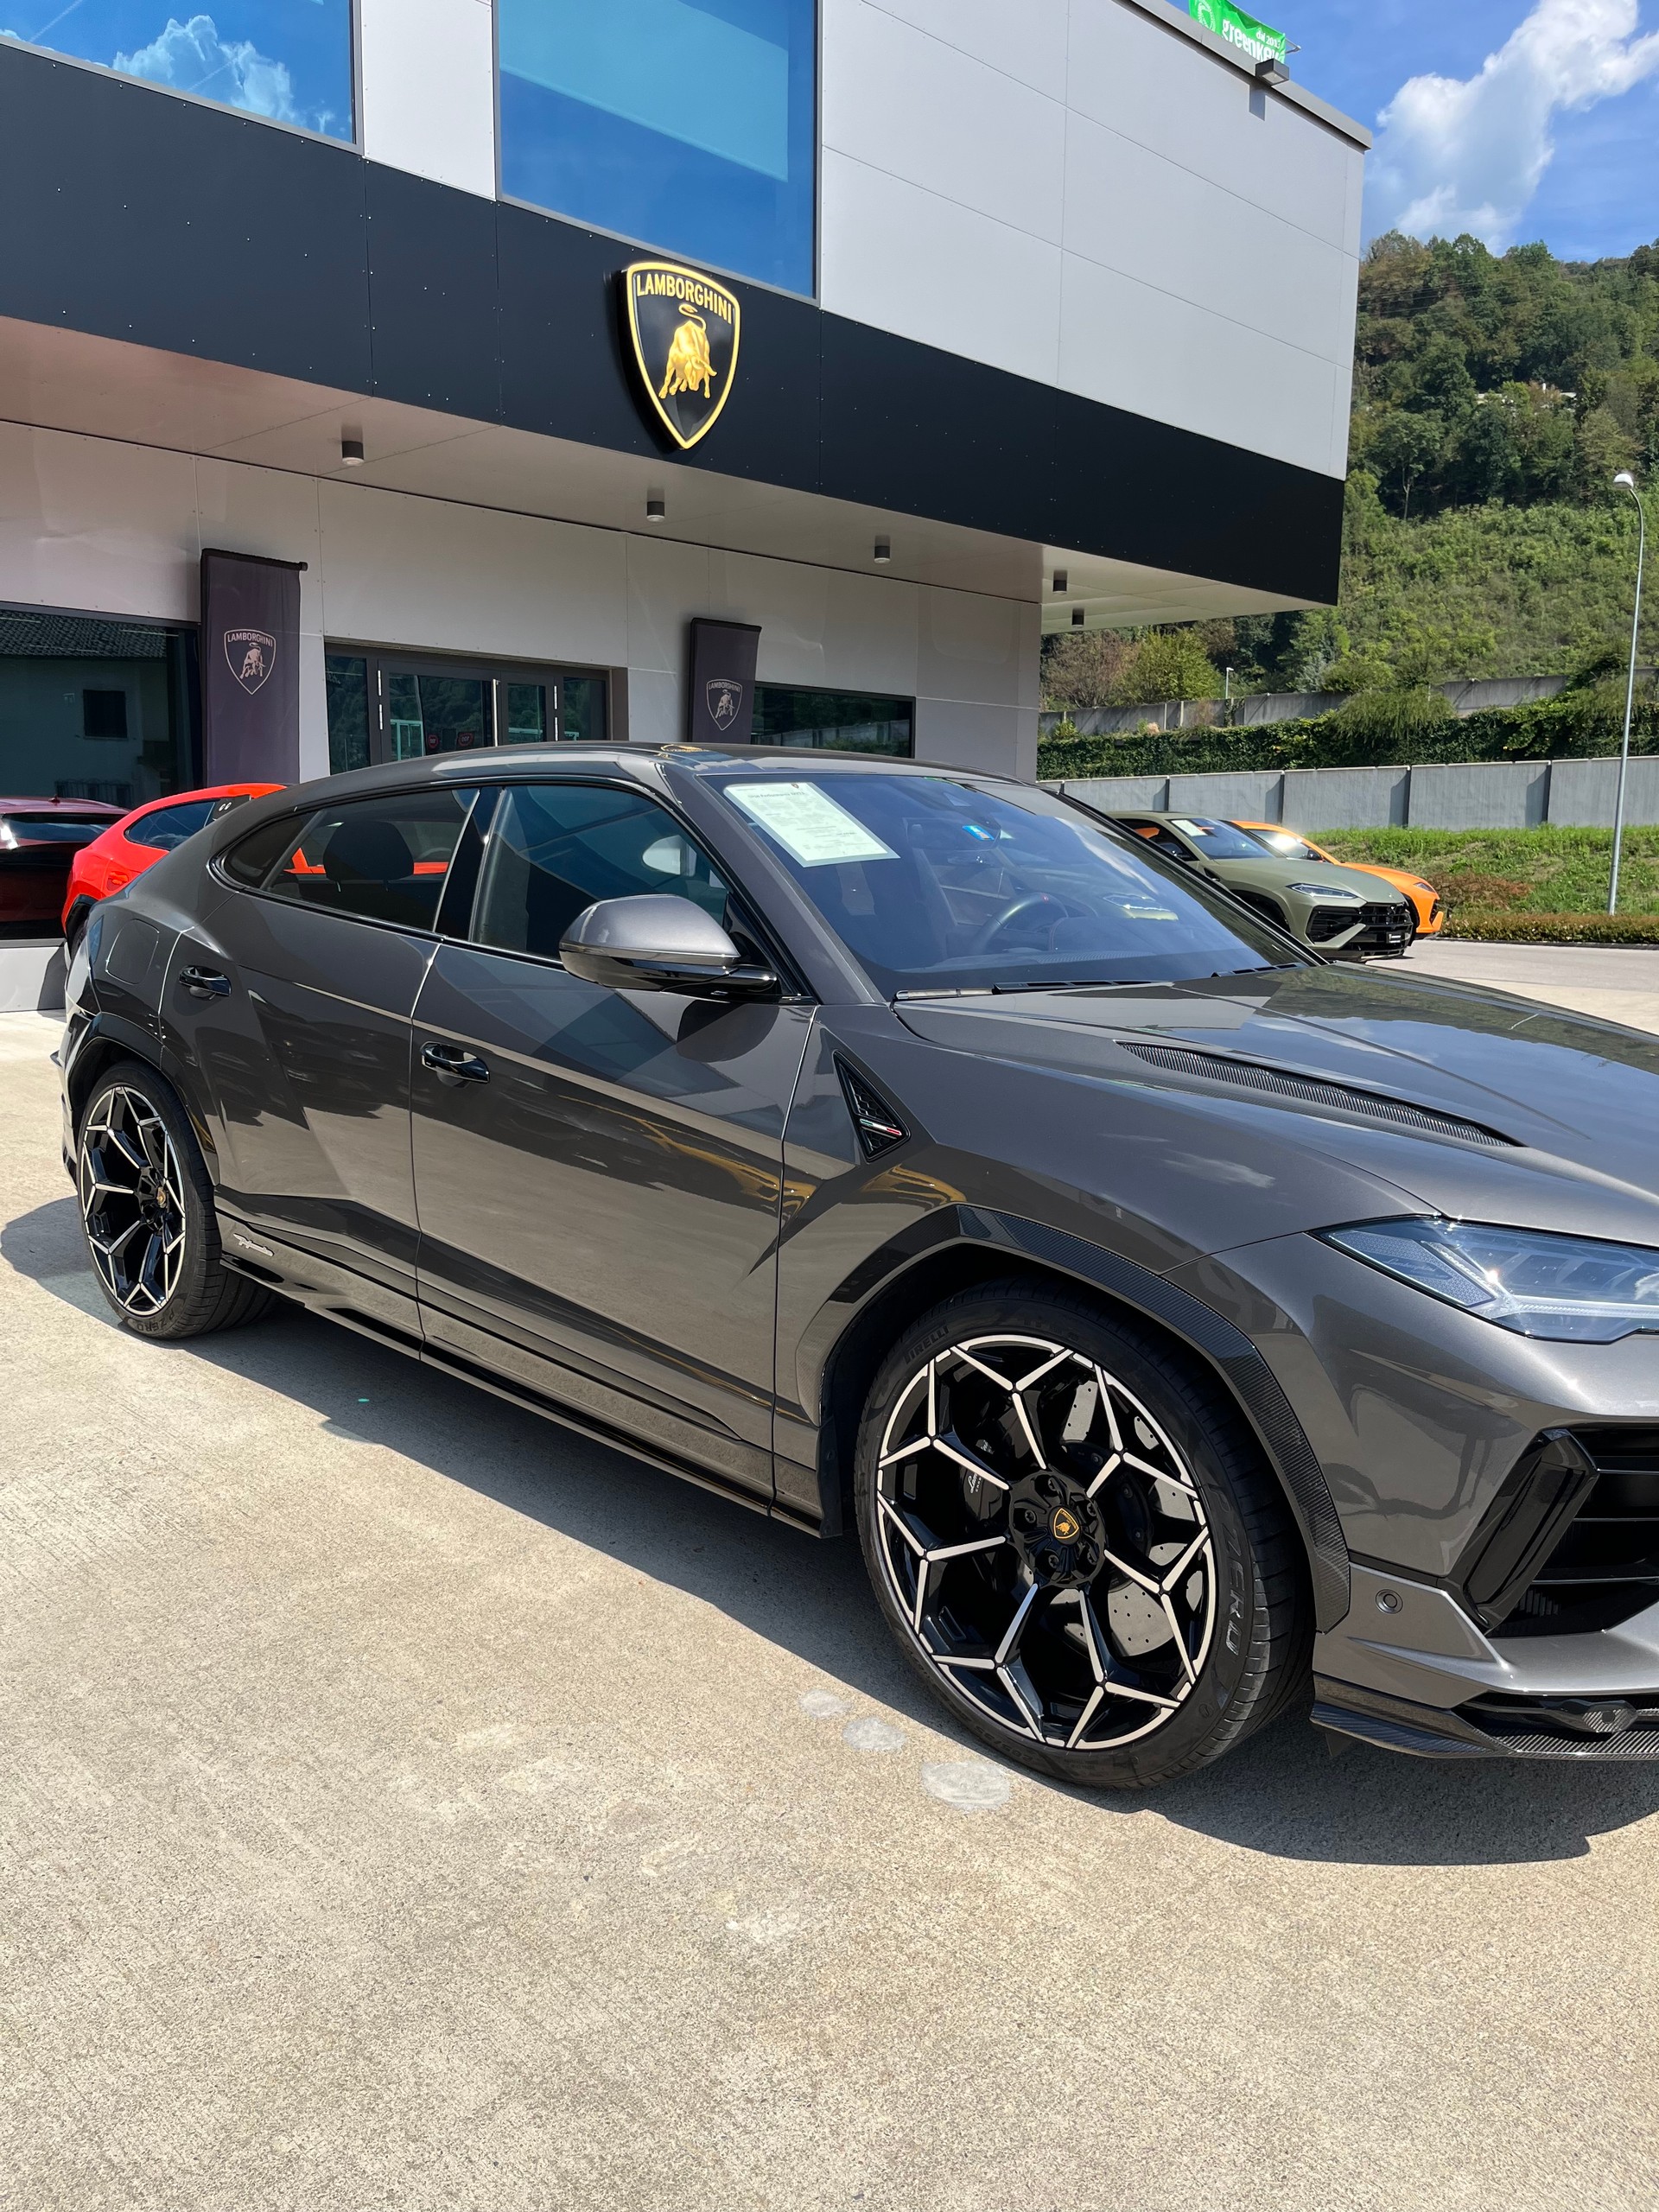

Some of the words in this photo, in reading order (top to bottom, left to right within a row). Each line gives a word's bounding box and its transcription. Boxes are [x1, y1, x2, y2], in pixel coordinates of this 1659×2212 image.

[636, 273, 733, 325] LAMBORGHINI
[227, 632, 273, 647] LAMBORGHINI
[709, 682, 741, 694] LAMBORGHINI
[137, 1317, 168, 1332] ZERO
[904, 1325, 950, 1365] PIRELLI
[1207, 1484, 1230, 1514] P
[1221, 1522, 1245, 1656] ZERO
